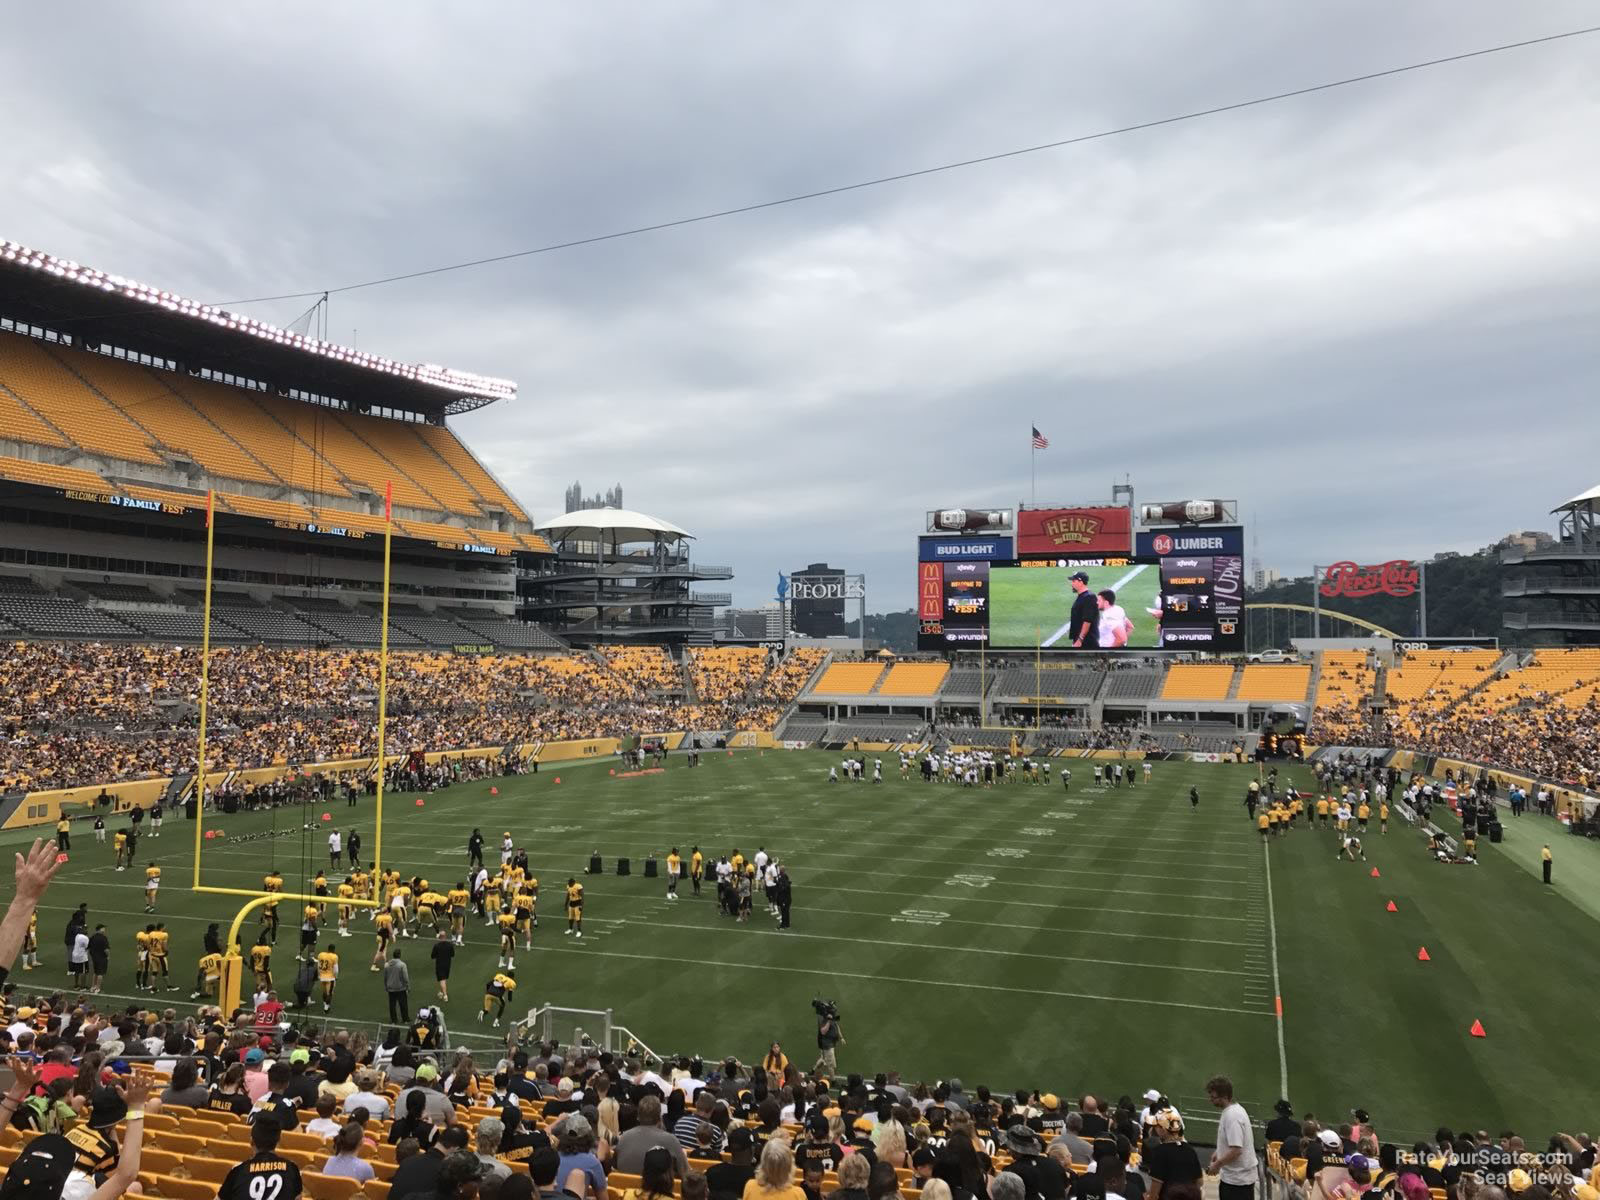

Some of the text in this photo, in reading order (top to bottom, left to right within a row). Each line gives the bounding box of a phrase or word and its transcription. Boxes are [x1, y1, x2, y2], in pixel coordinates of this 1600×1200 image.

[122, 498, 161, 511] FAMILY
[162, 503, 185, 514] FEST
[1046, 518, 1098, 536] HEINZ
[937, 545, 994, 555] BUD LIGHT
[1154, 537, 1223, 551] 84 LUMBER
[1068, 559, 1104, 567] FAMILY
[1104, 558, 1129, 566] FEST
[792, 582, 865, 599] PEOPLES
[955, 605, 977, 613] FEST
[944, 874, 997, 888] 20
[891, 909, 951, 926] 10
[319, 959, 329, 971] 33
[257, 1010, 275, 1024] 29
[211, 1099, 232, 1111] MILLER
[249, 1161, 287, 1173] HARRISON
[1322, 1156, 1345, 1164] GREEN
[249, 1173, 283, 1200] 92
